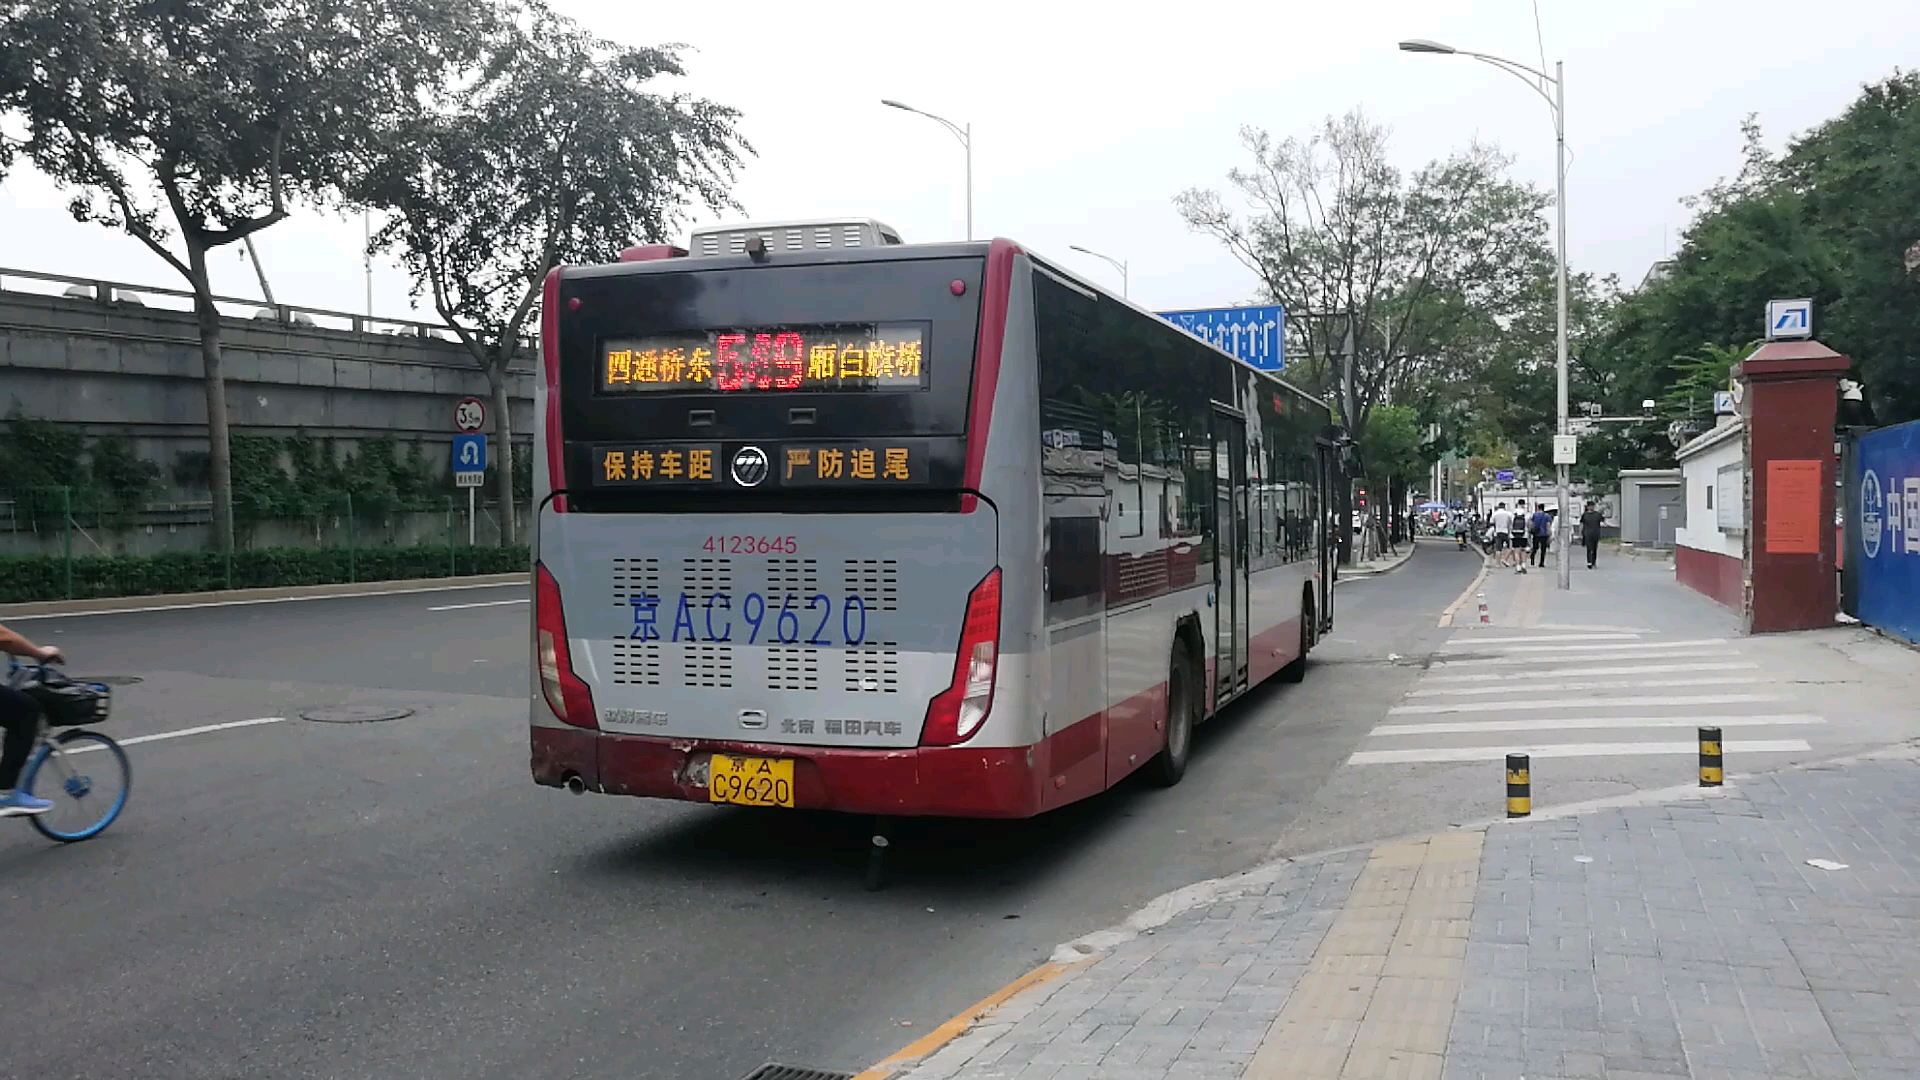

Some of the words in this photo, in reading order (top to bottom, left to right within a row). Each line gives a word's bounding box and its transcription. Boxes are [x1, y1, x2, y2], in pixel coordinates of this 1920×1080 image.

[607, 347, 712, 384] 四通桥东
[603, 450, 713, 480] 保持车距
[786, 448, 910, 480] 严防追尾
[702, 536, 798, 554] 4123645
[629, 592, 867, 647] 京AC9620
[781, 718, 815, 735] 北京
[824, 719, 902, 737] 福田汽车
[713, 773, 789, 804] C9620
